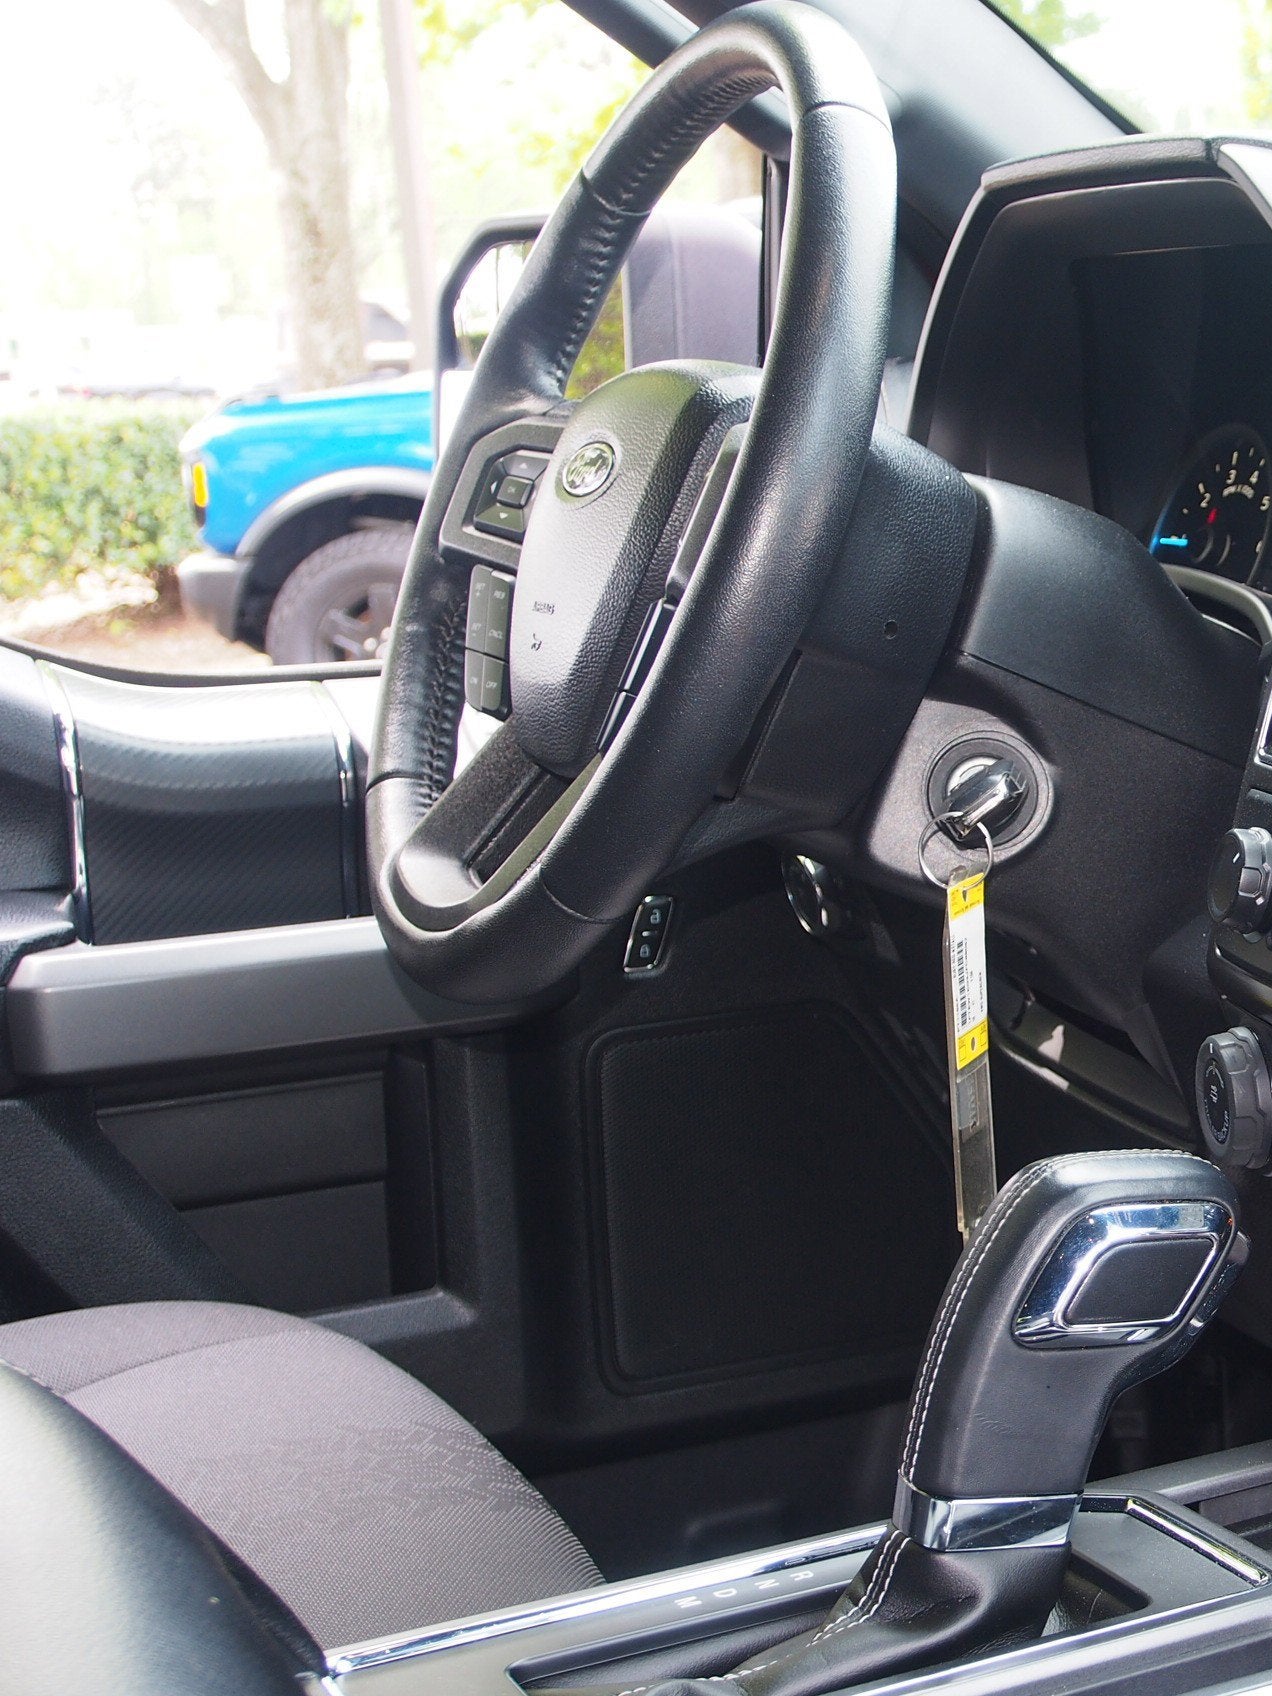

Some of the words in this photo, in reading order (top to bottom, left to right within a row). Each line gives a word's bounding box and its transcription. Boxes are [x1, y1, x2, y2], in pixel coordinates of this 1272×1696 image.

[1226, 469, 1237, 484] 3
[1200, 493, 1211, 508] 2
[1260, 496, 1271, 511] 5
[789, 1570, 815, 1581] R
[713, 1587, 738, 1598] D
